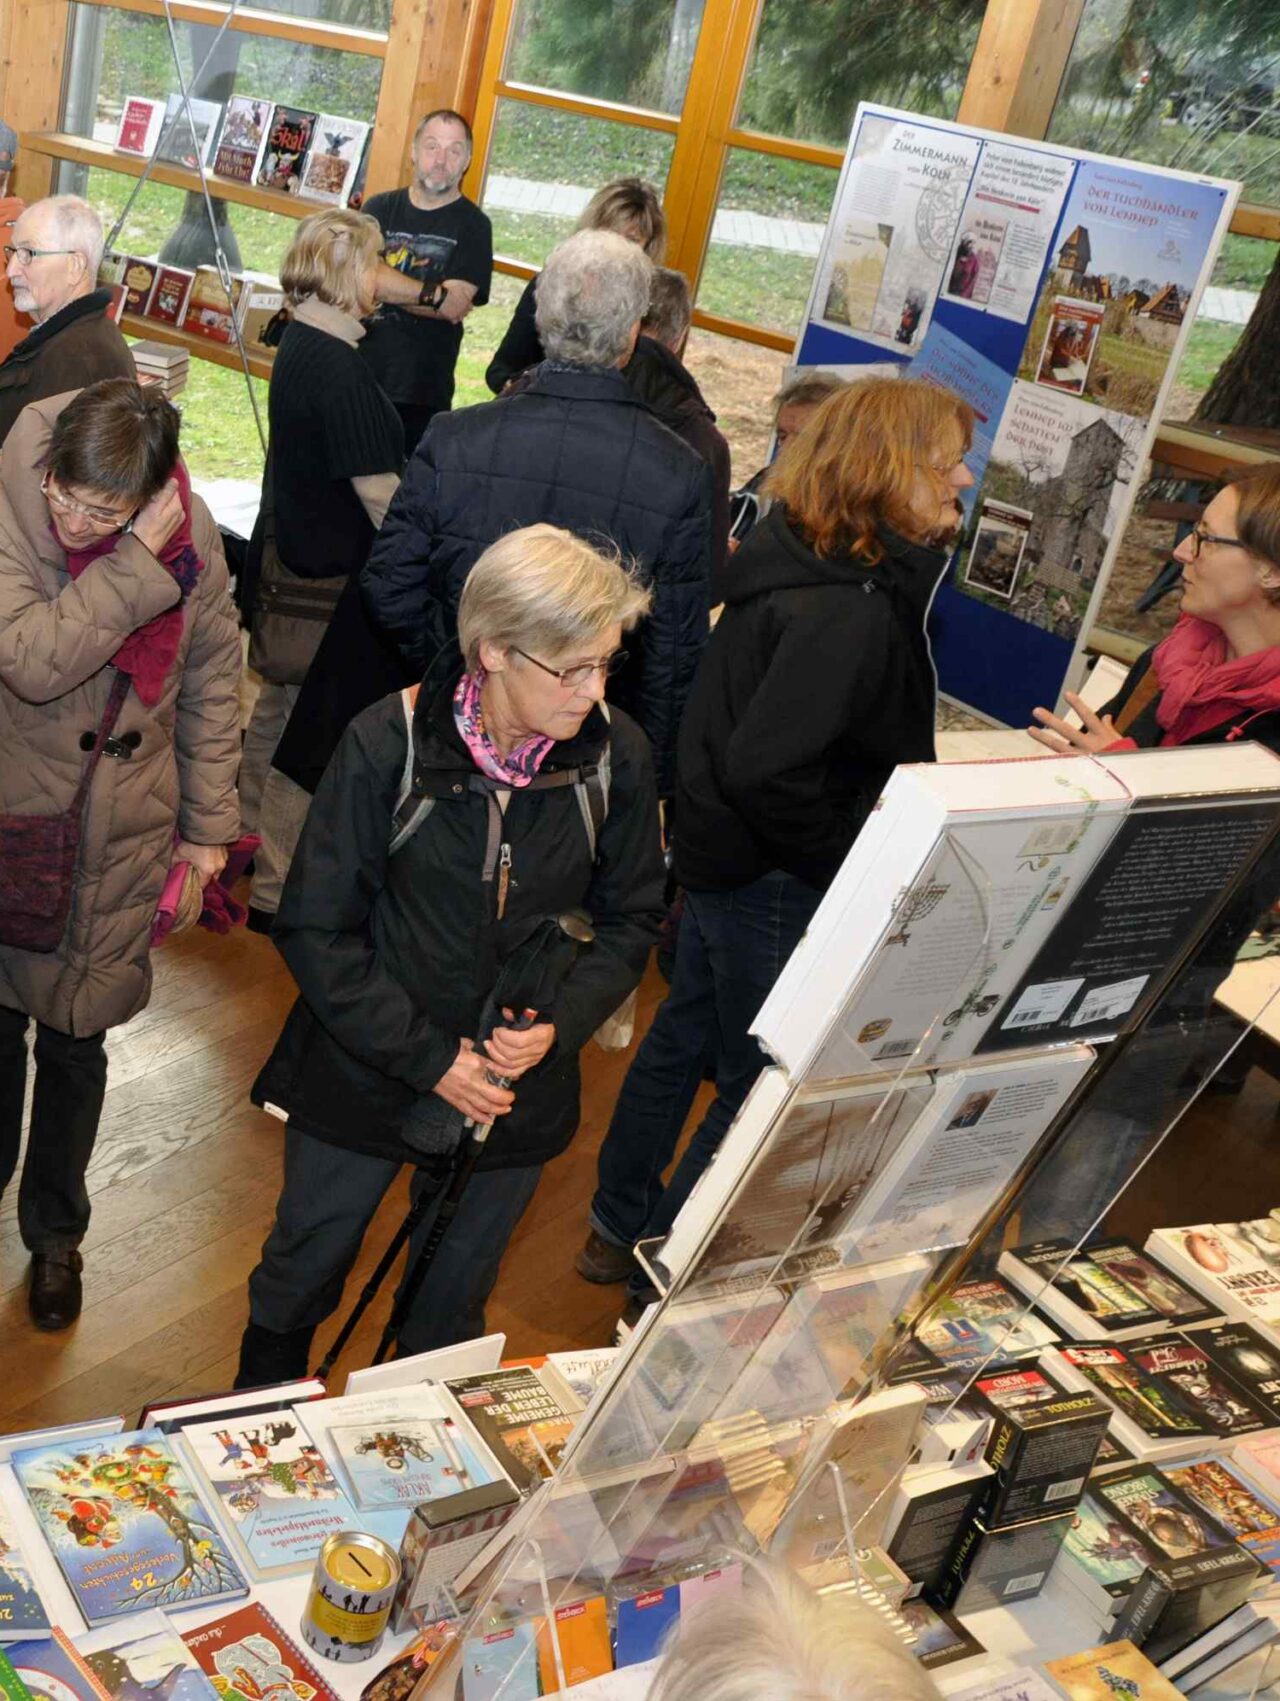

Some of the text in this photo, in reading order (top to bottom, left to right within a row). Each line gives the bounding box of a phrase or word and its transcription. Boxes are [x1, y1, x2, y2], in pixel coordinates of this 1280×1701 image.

[892, 138, 968, 168] ZIMMERMANN
[483, 1401, 510, 1416] DER
[513, 1395, 554, 1412] LEBEN
[504, 1406, 561, 1425] GEHEIME
[990, 1425, 1013, 1472] OTHOLZ
[129, 1571, 158, 1591] 24
